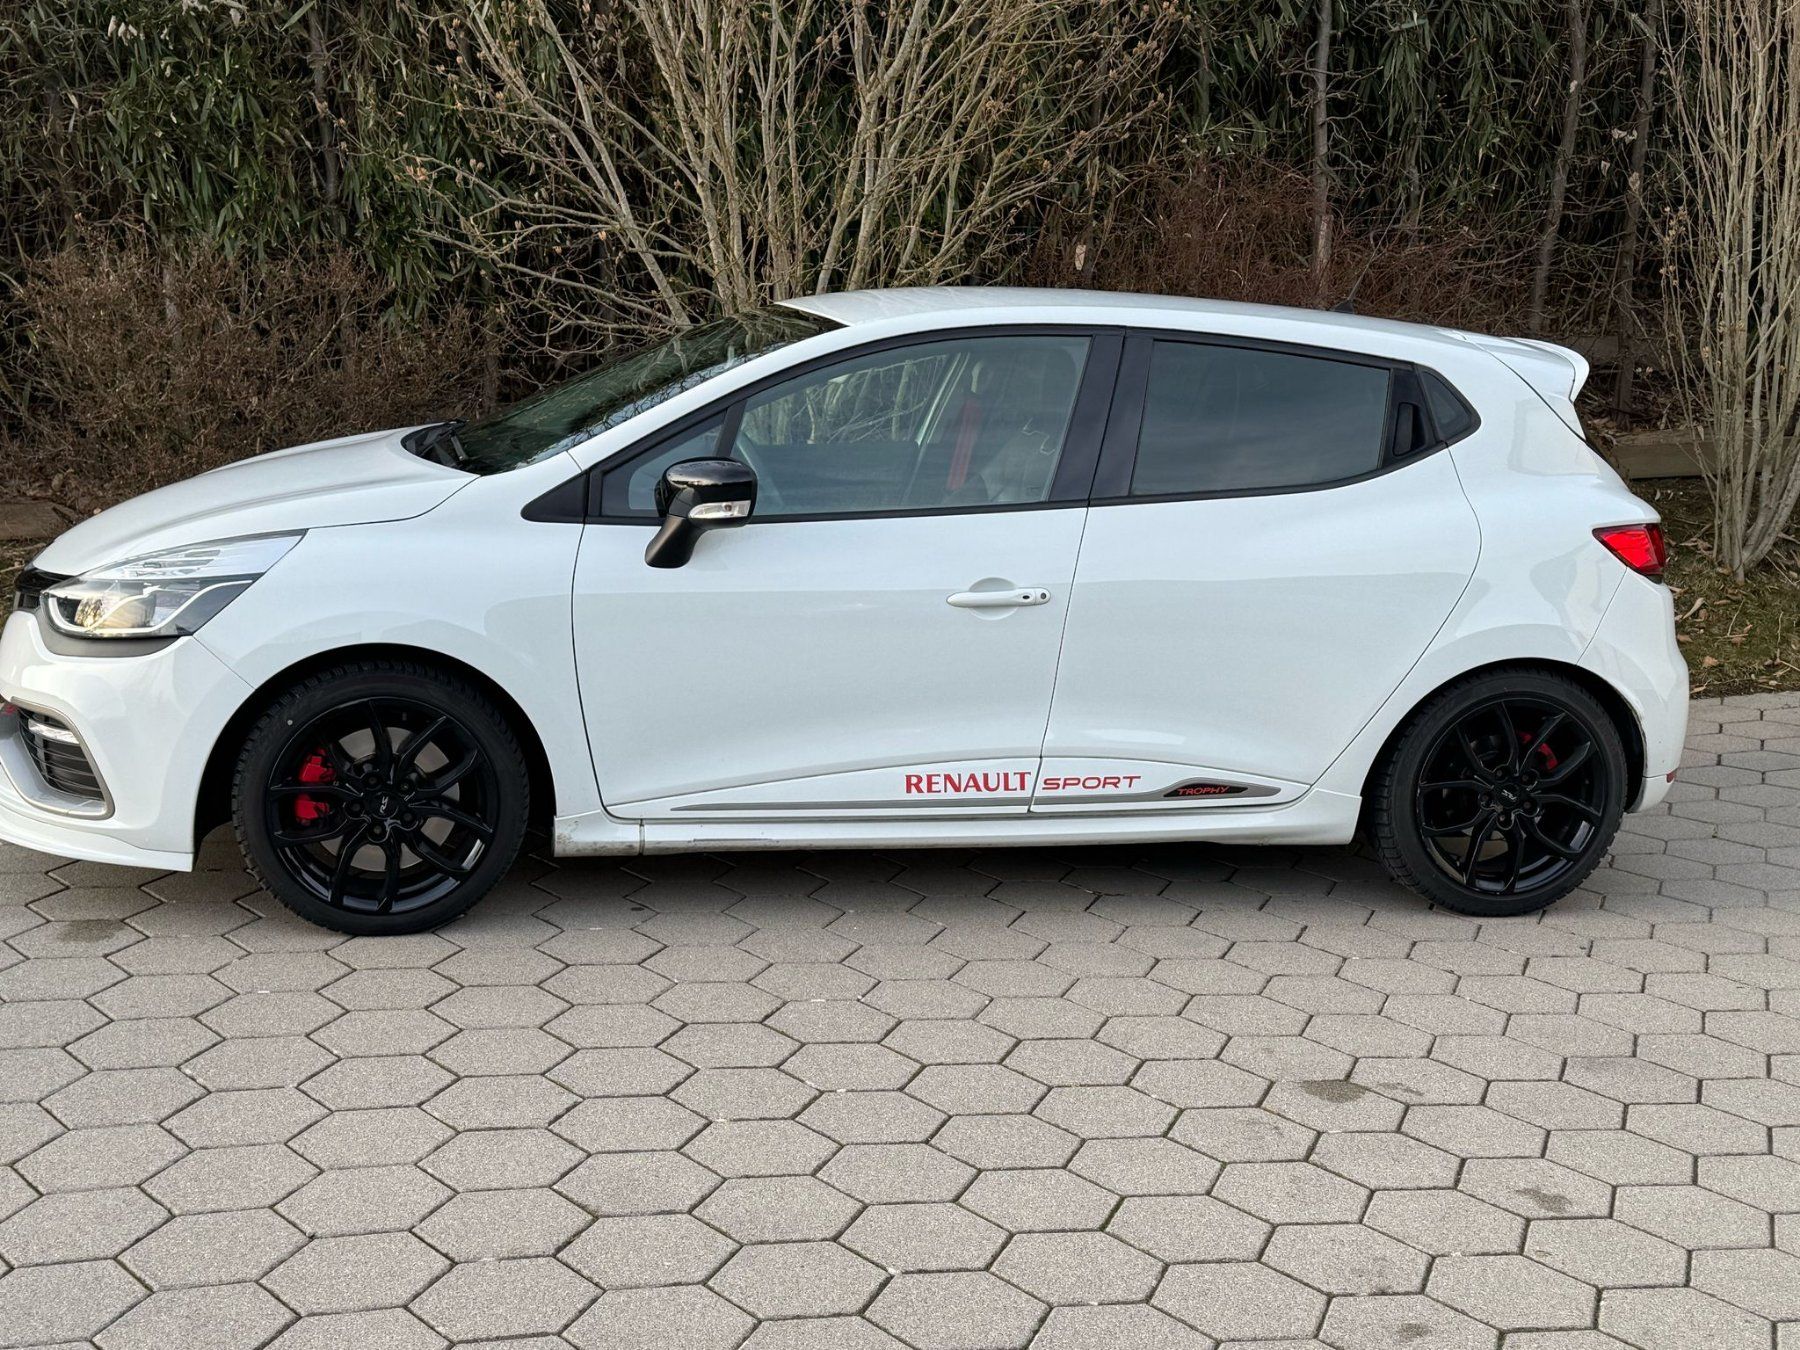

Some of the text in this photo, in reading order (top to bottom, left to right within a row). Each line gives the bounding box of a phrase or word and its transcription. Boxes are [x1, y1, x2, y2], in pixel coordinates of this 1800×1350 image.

[905, 772, 1141, 793] RENAULT SPORT
[1177, 786, 1230, 795] TROPHY
